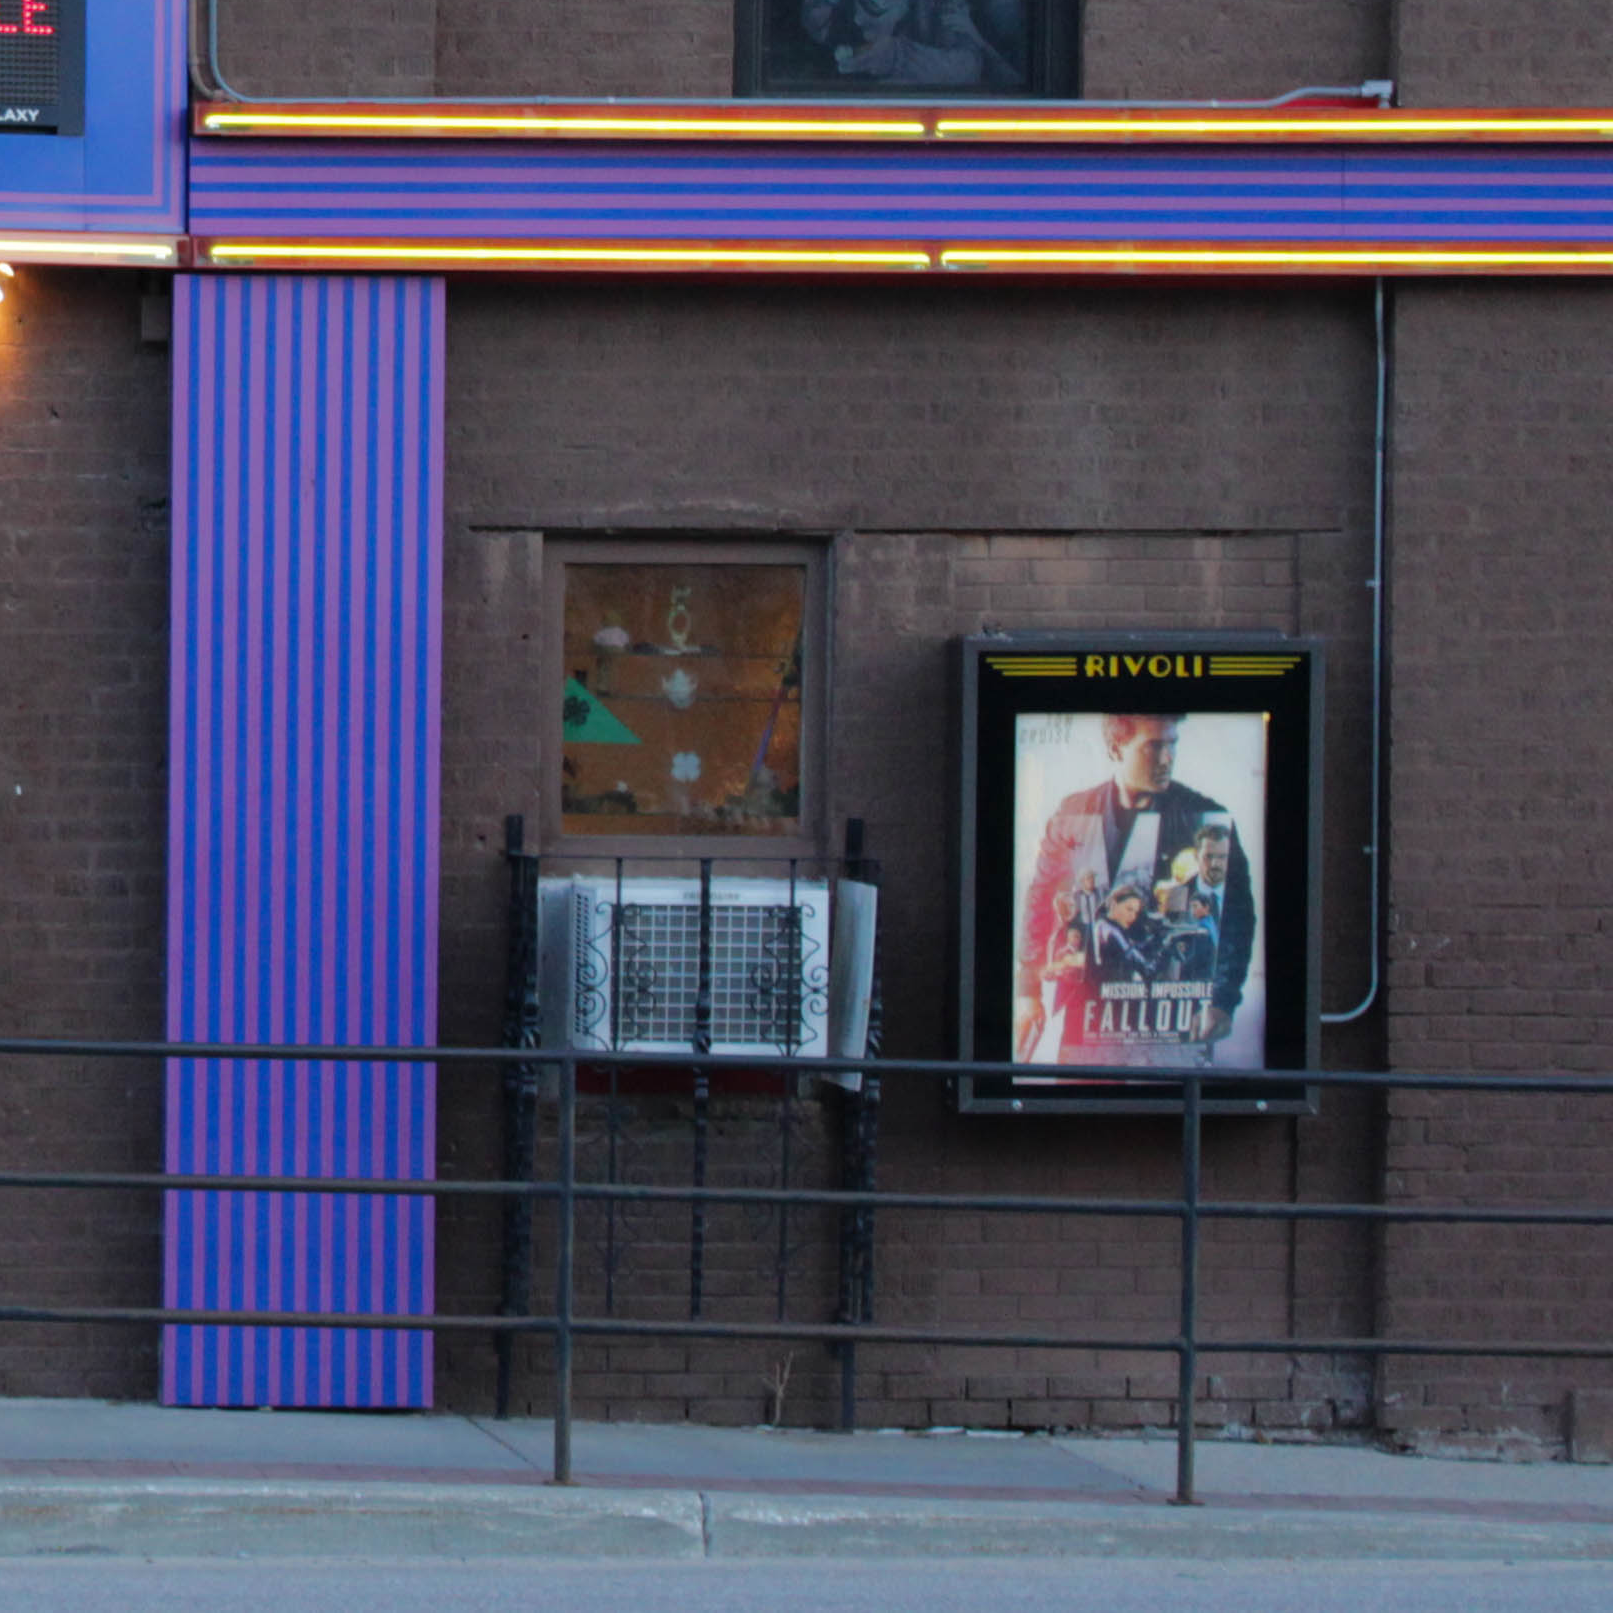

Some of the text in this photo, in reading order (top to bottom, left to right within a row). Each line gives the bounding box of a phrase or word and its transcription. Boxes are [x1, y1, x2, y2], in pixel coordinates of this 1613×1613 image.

[1084, 654, 1203, 677] RIVOLI
[1151, 980, 1214, 999] IMPOSSIBLE
[1083, 999, 1213, 1033] FALLOUT
